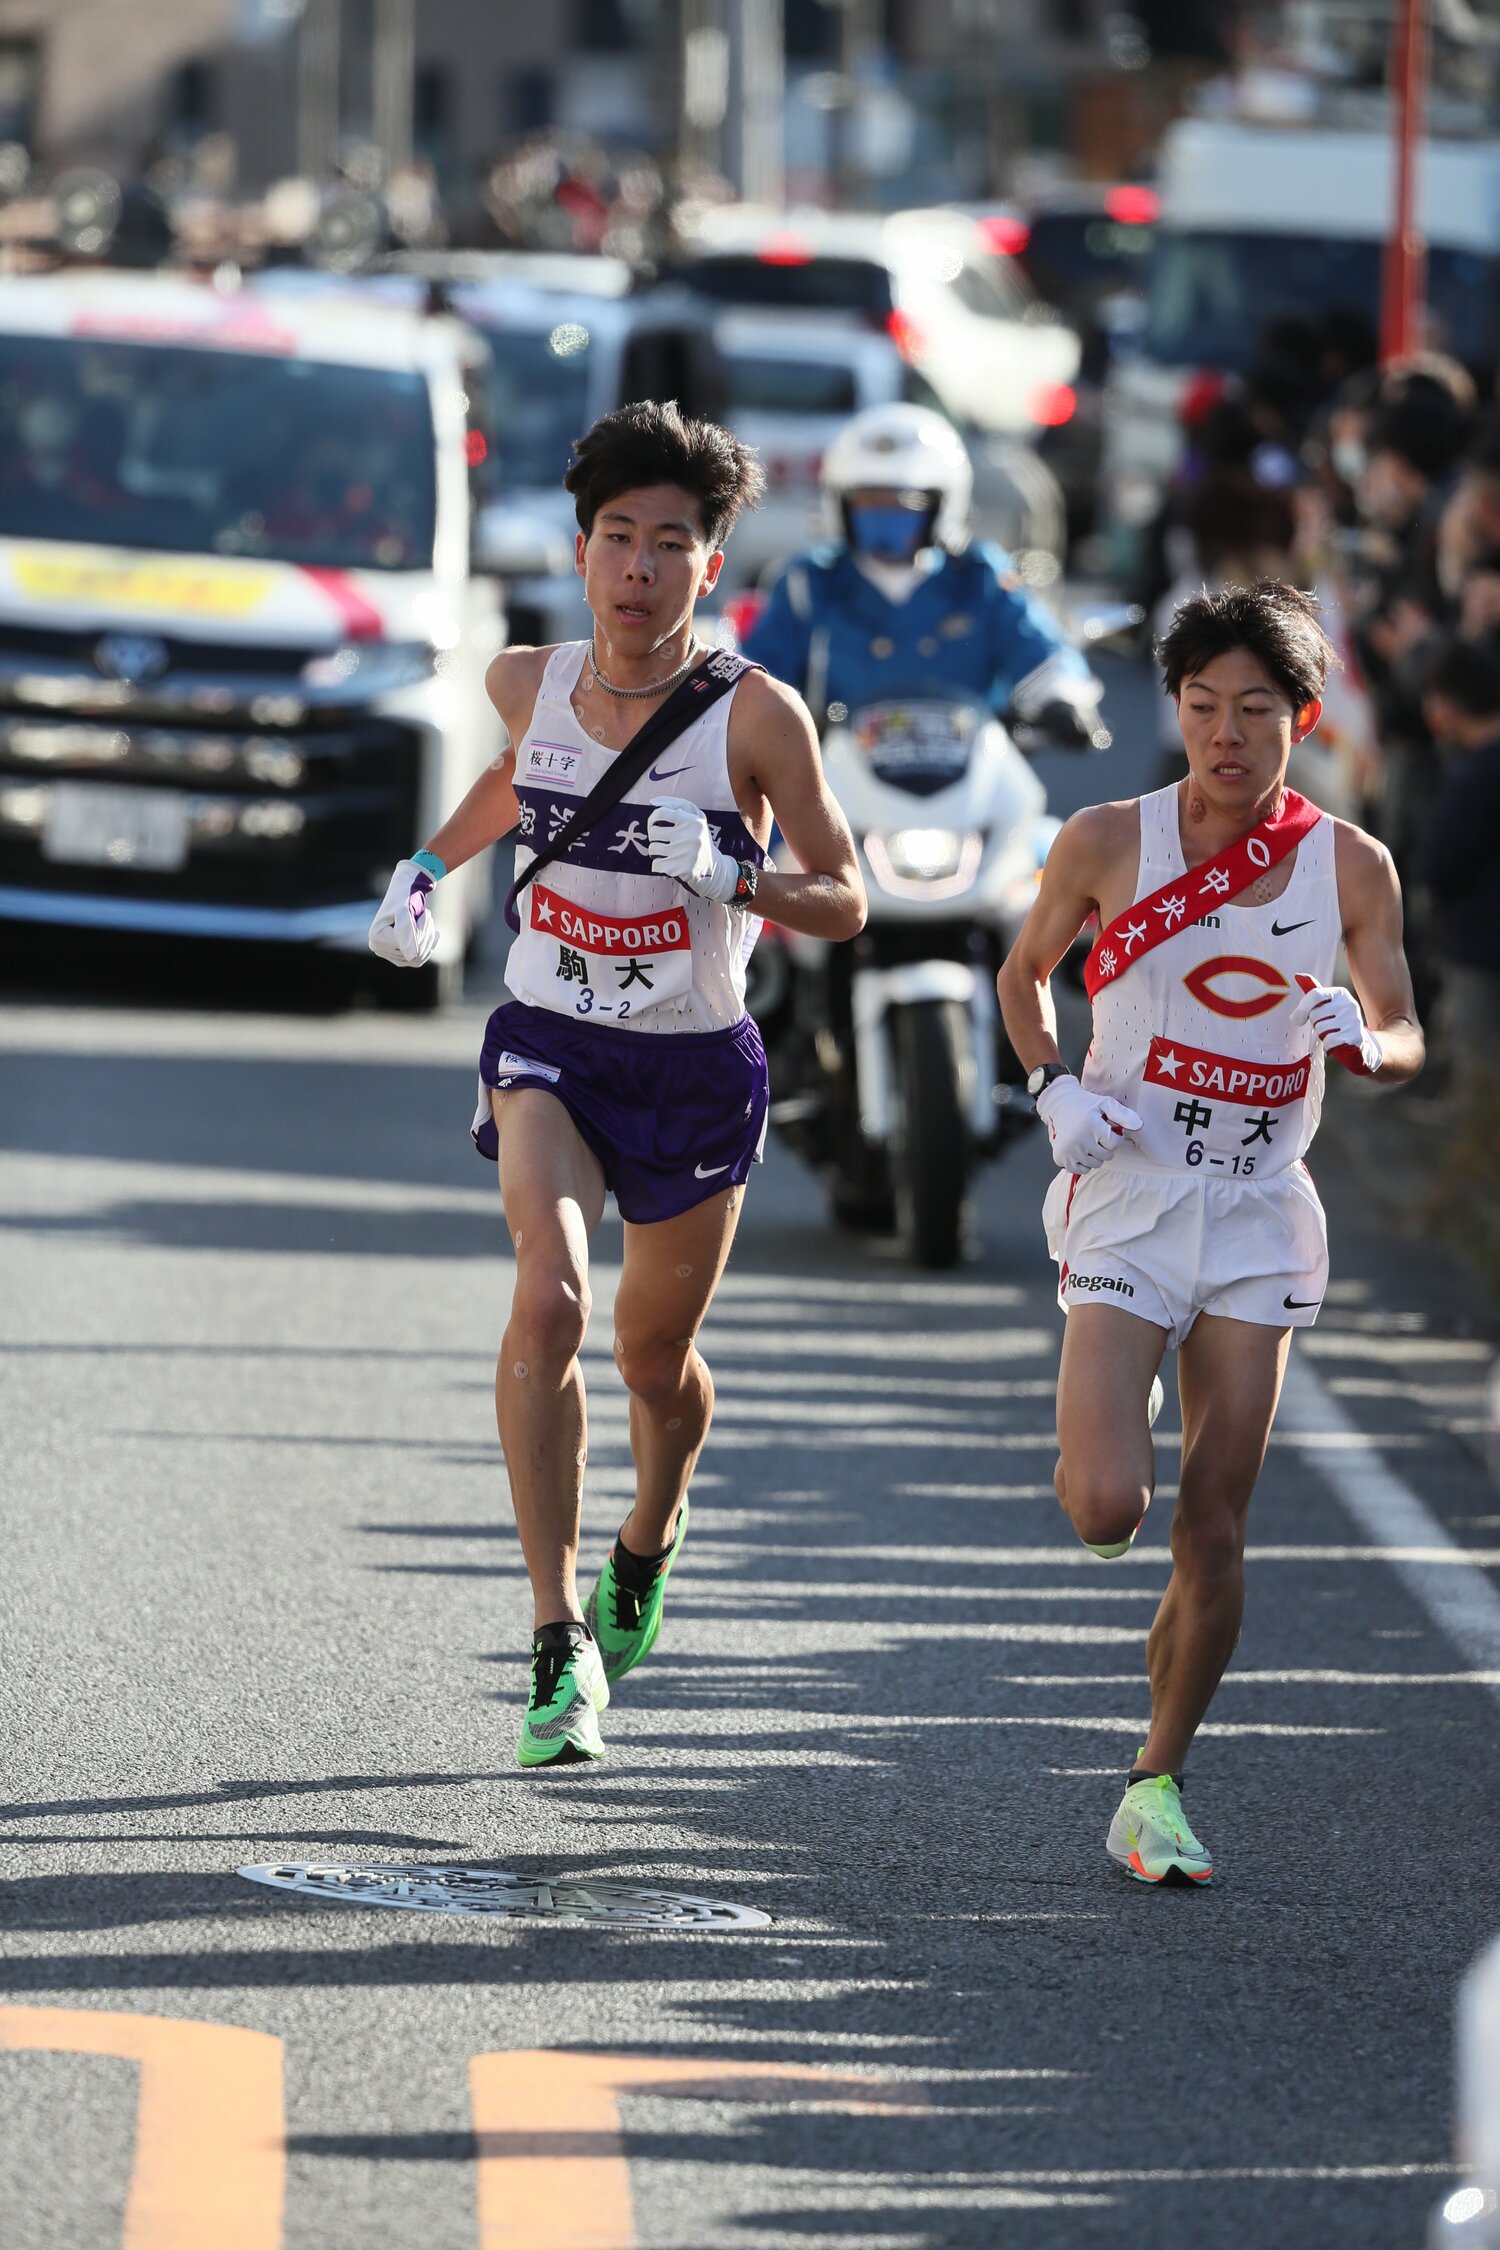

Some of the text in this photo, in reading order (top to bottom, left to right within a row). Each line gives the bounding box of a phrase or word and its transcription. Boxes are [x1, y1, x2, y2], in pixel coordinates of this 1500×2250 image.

[530, 749, 575, 771] 桜十字
[560, 910, 682, 948] SAPPORO
[575, 988, 631, 1019] 3-2
[1189, 1060, 1305, 1099] SAPPORO
[1185, 1140, 1256, 1175] 6-15
[1068, 1273, 1135, 1298] Regain
